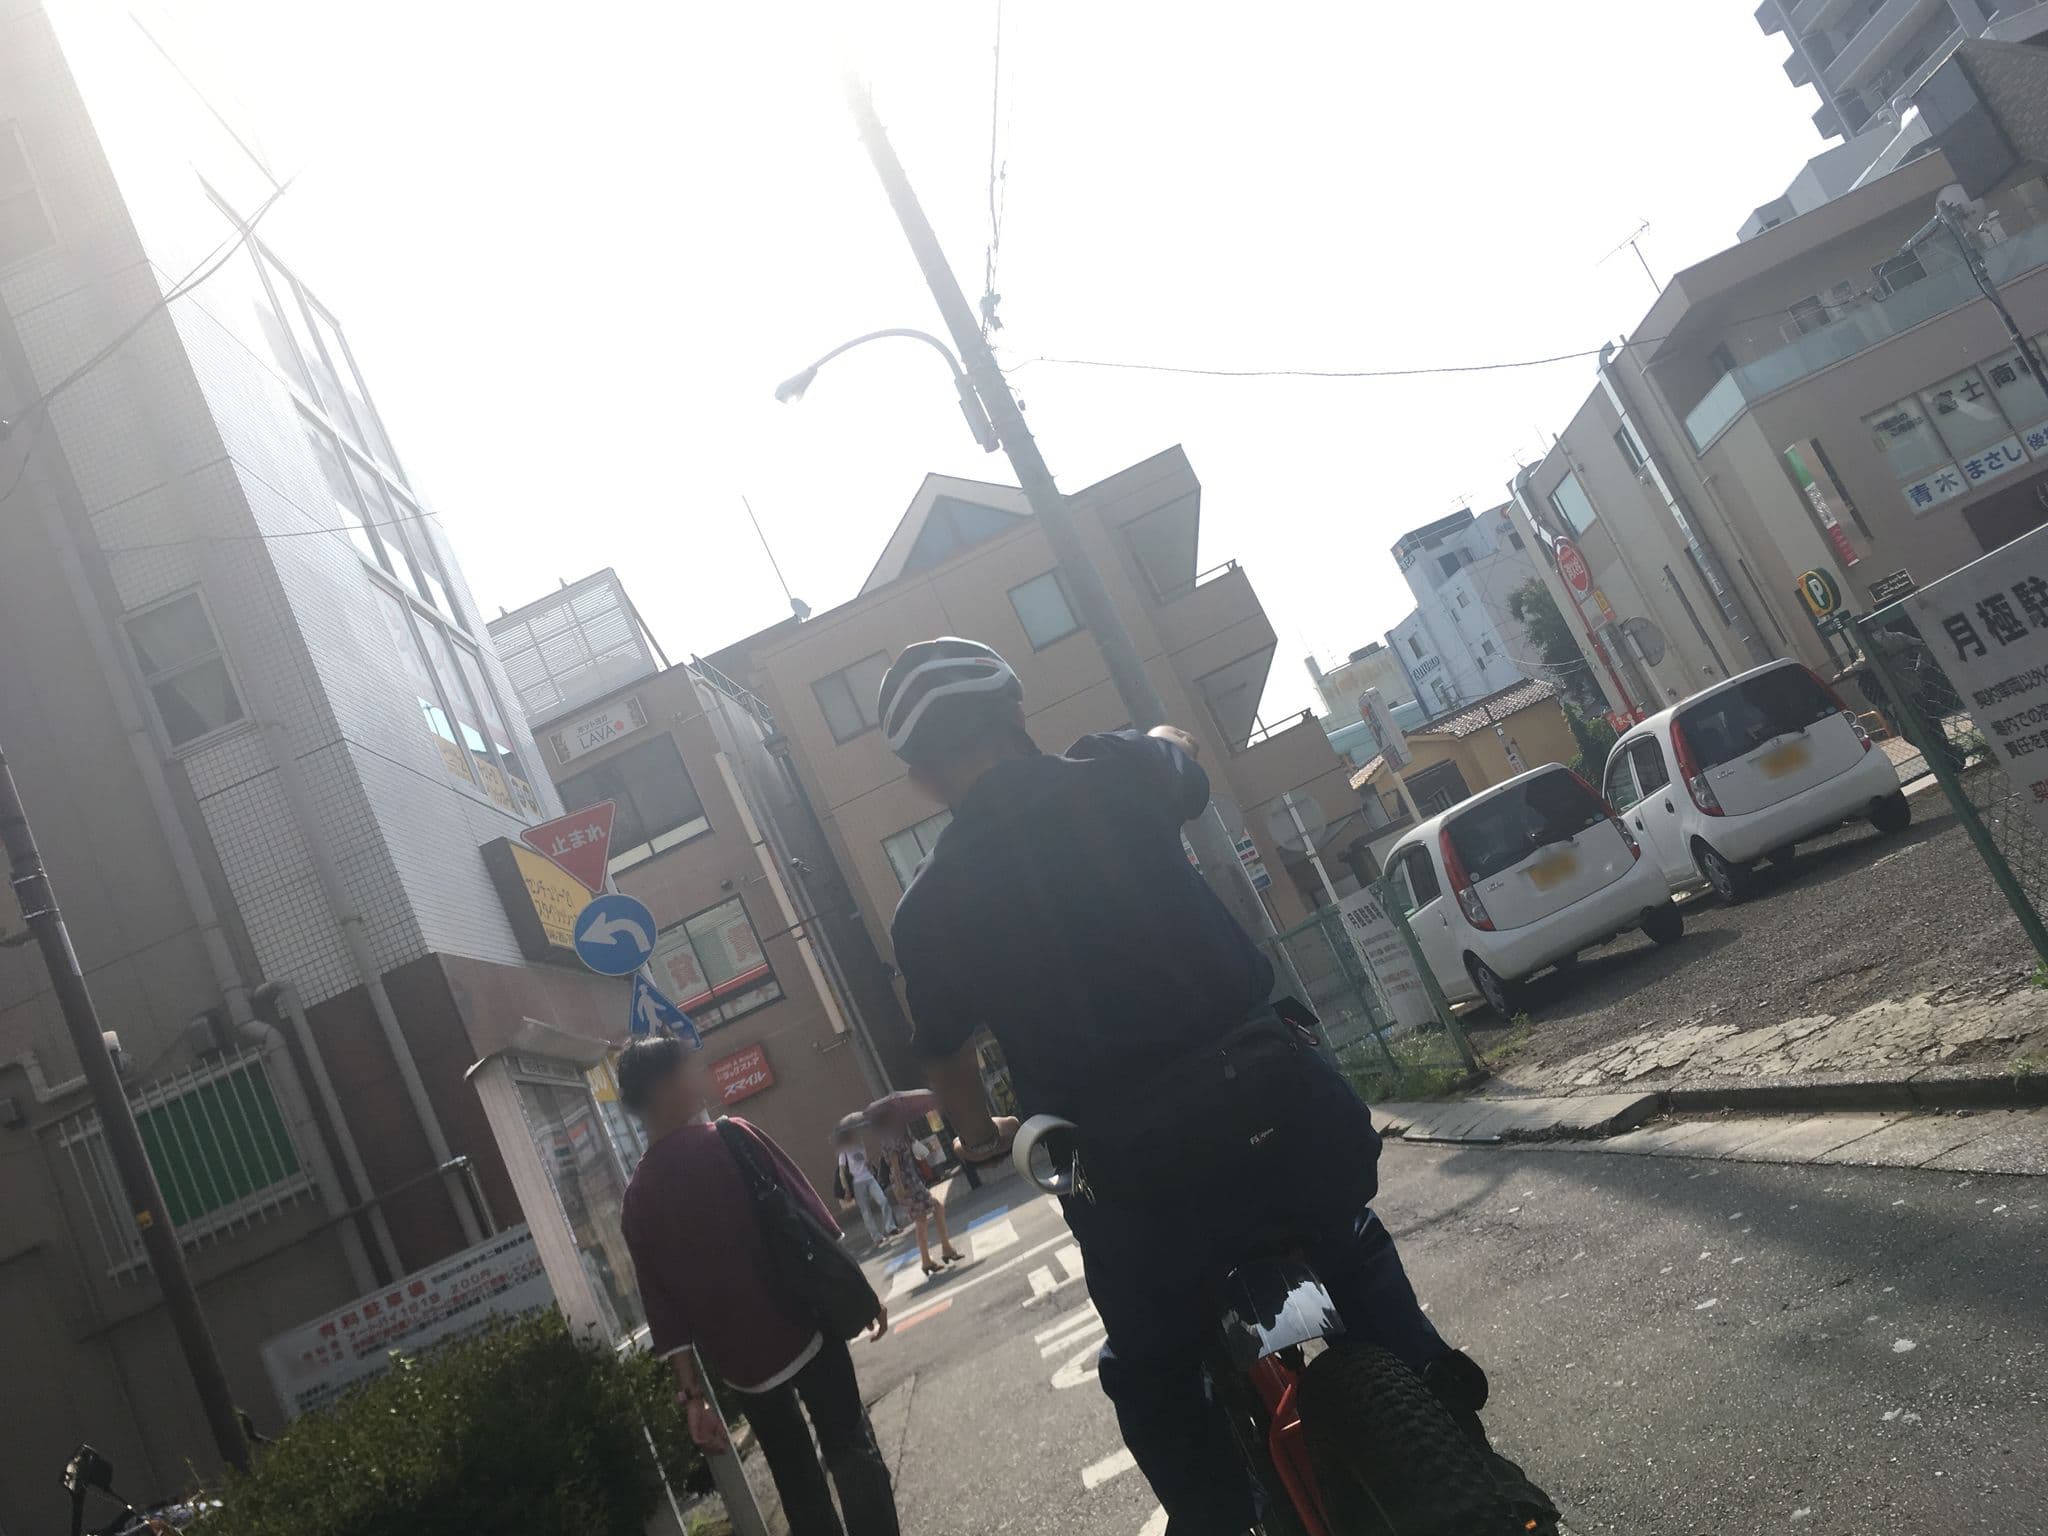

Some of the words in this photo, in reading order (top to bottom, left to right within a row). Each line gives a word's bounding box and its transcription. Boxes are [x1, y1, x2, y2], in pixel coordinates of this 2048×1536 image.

[1909, 472, 1961, 507] 青木
[1965, 446, 2022, 480] まさし
[579, 725, 617, 751] LAVA
[551, 824, 606, 858] 止まれ
[724, 1071, 767, 1098] スマイル
